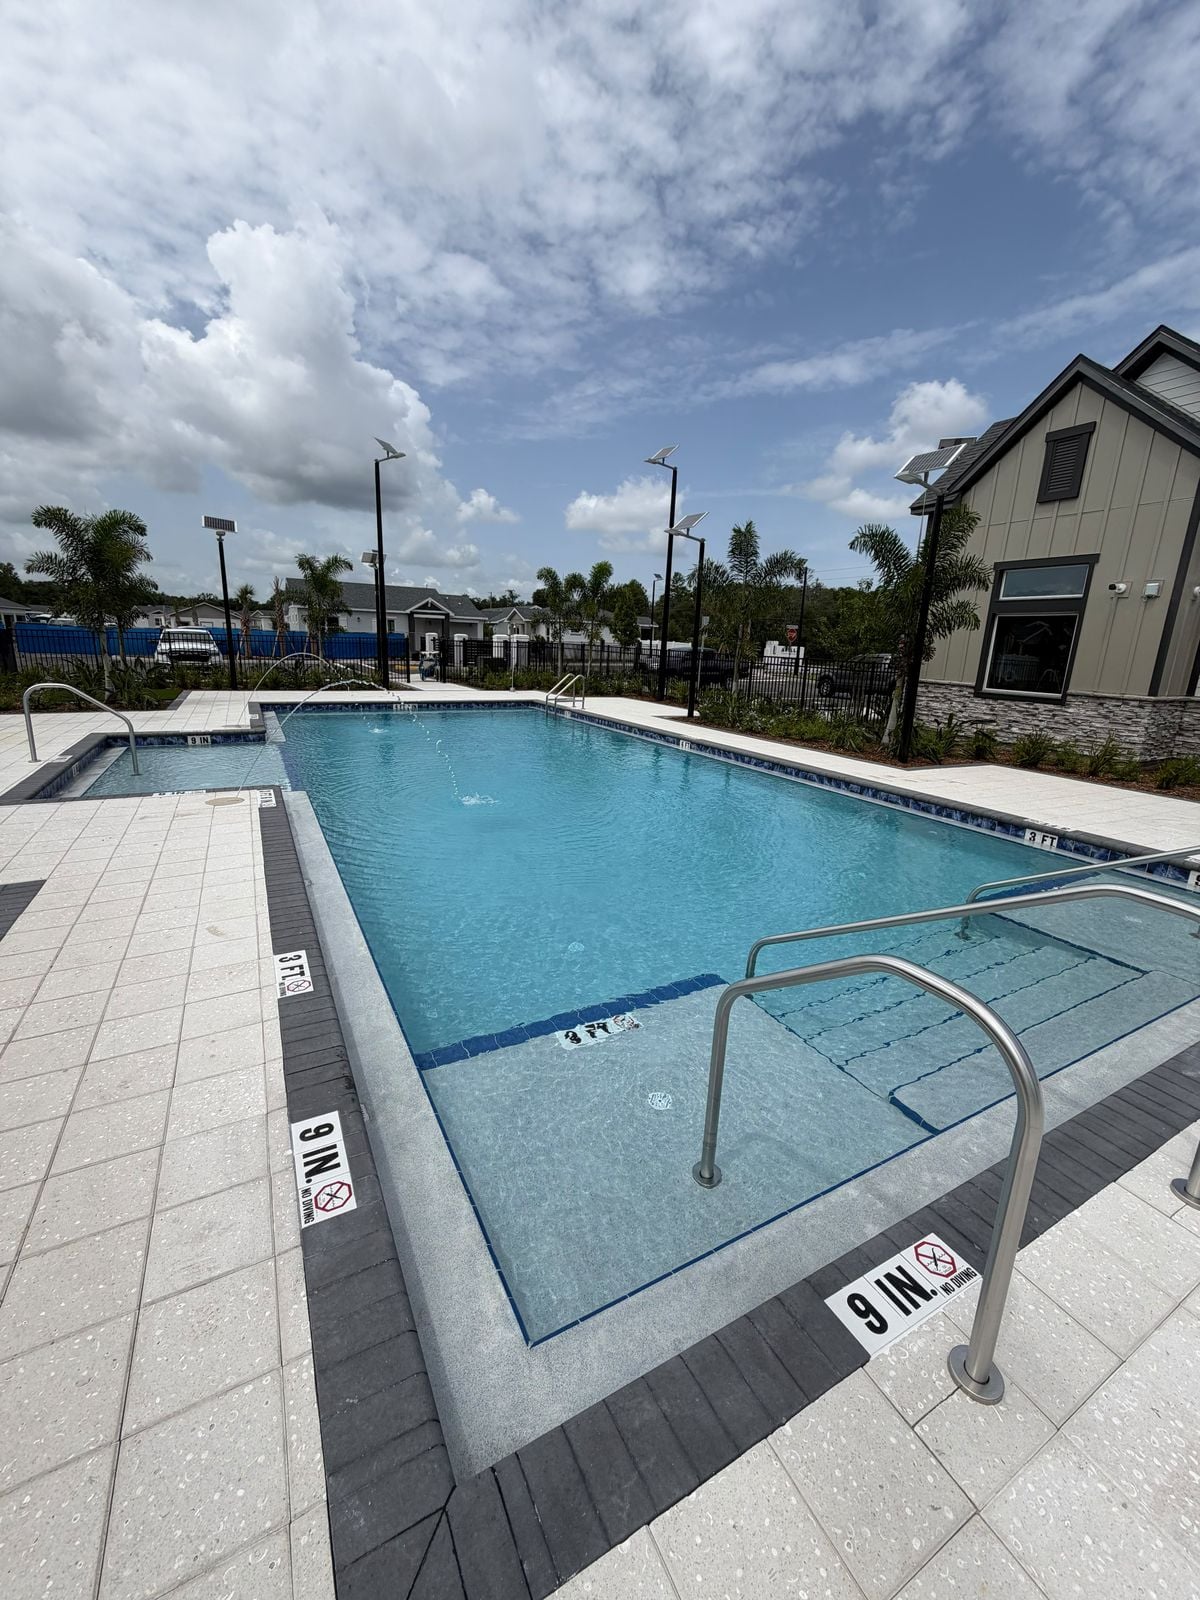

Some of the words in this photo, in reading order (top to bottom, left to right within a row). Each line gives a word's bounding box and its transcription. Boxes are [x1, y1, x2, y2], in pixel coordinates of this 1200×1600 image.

[1029, 831, 1037, 842] 3
[278, 954, 302, 963] 3
[299, 1122, 335, 1142] 9
[302, 1143, 341, 1184] IN.
[301, 1187, 312, 1198] NO
[302, 1199, 315, 1225] DIVING
[939, 1282, 955, 1296] NO
[950, 1267, 978, 1289] DIVING
[846, 1292, 889, 1335] 9
[873, 1264, 938, 1317] IN.
